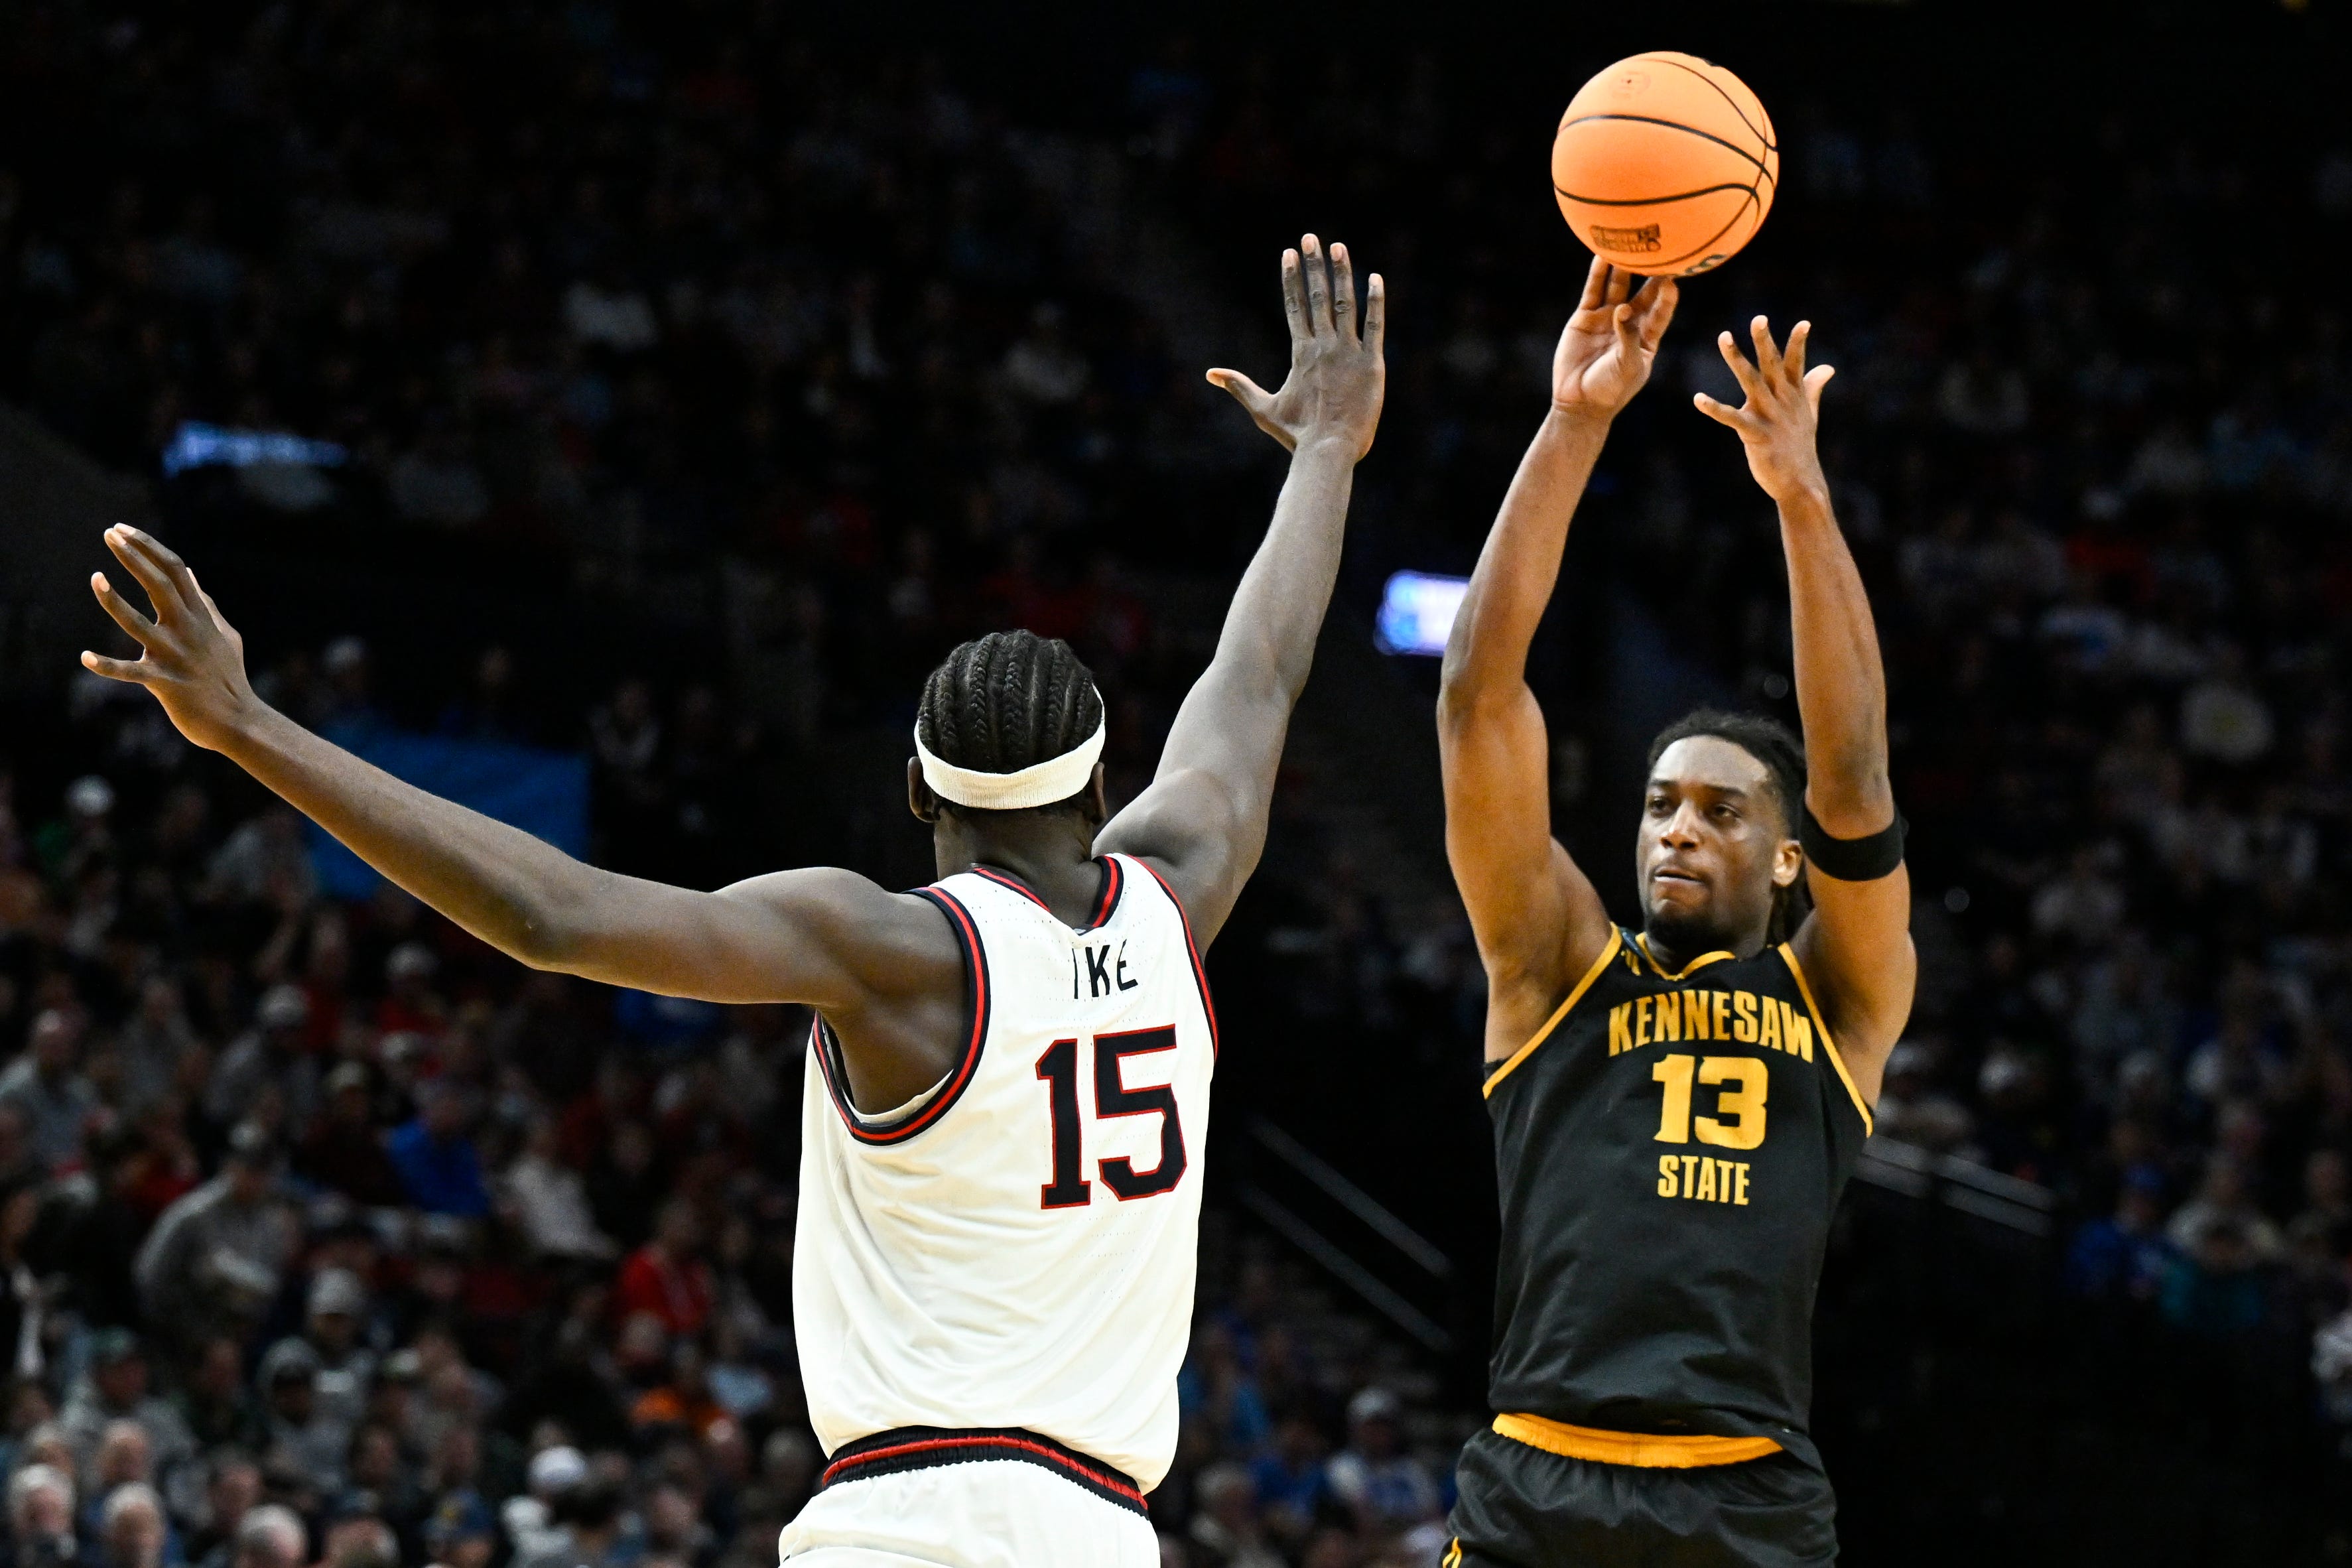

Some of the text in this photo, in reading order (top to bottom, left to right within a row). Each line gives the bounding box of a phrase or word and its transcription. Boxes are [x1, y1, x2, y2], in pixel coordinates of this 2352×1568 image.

[1072, 939, 1138, 999] IKE
[1608, 989, 1813, 1064] KENNESAW
[1035, 1023, 1187, 1210] 15
[1652, 1053, 1768, 1150] 13
[1657, 1154, 1750, 1206] STATE
